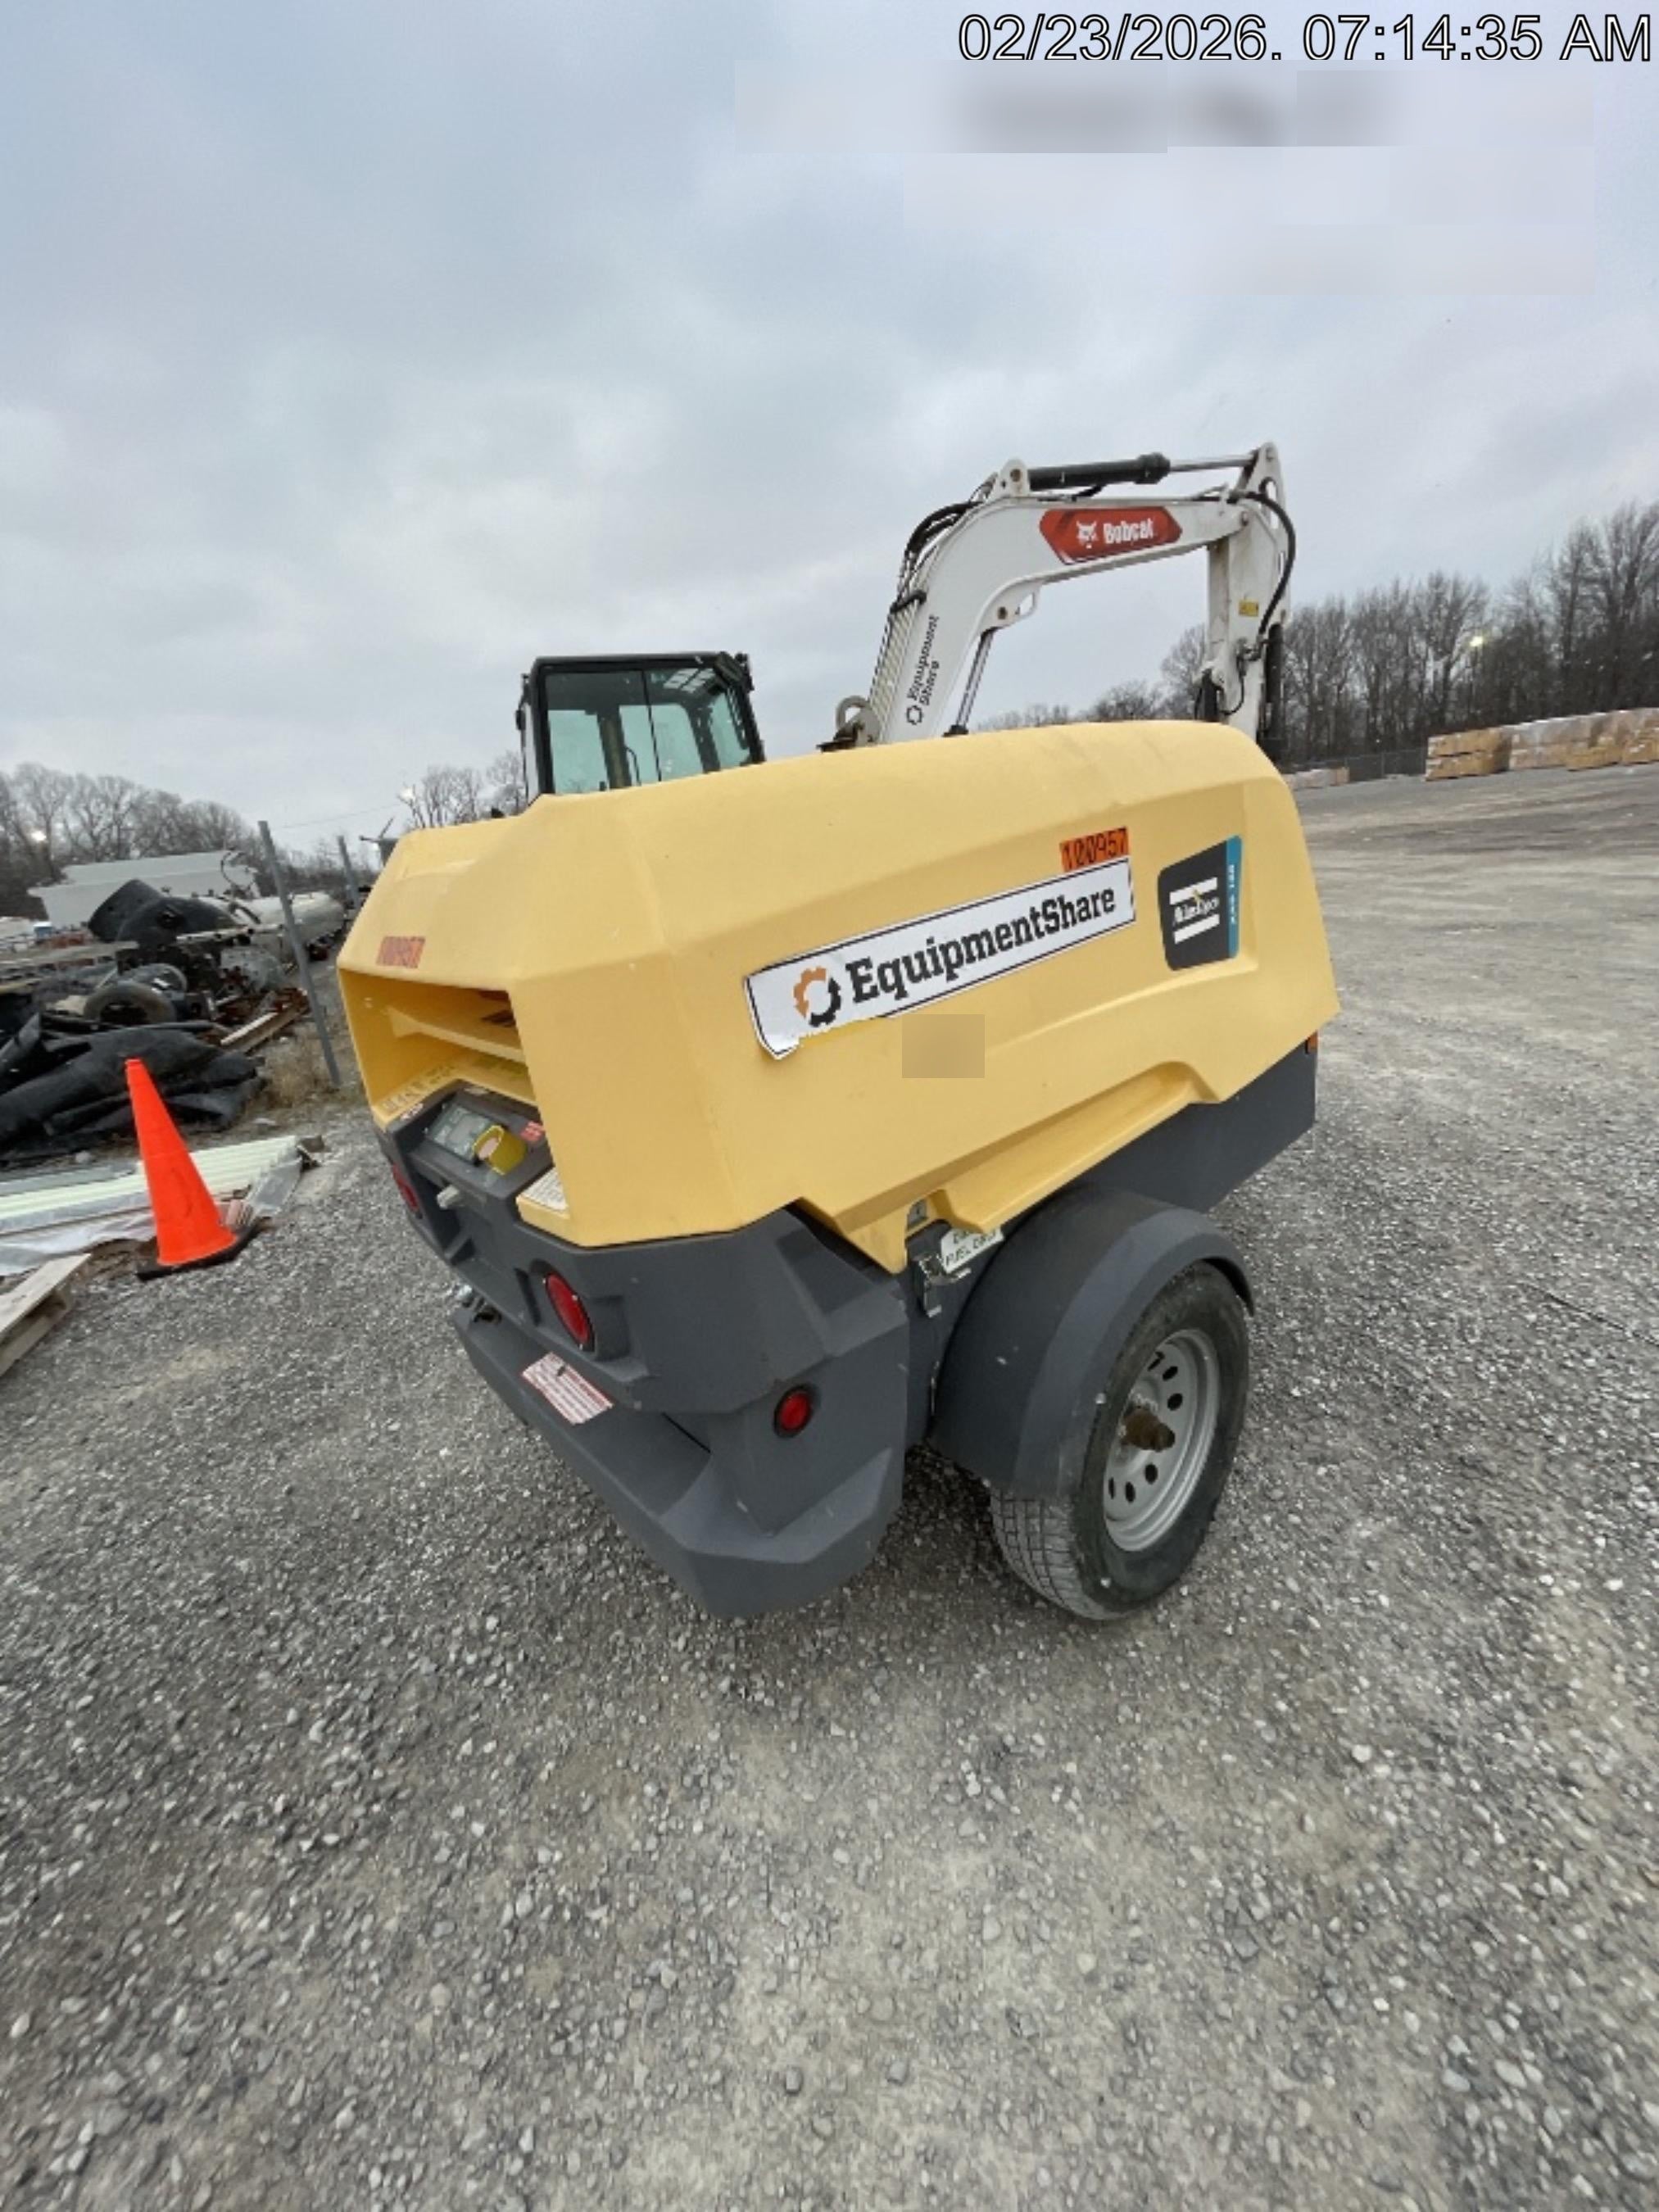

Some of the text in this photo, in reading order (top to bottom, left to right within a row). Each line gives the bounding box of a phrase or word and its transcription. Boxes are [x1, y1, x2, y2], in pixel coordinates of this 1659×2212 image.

[1103, 518, 1154, 544] Bobcat
[1062, 827, 1127, 869] 100957
[845, 886, 1116, 1005] EquipmentShare
